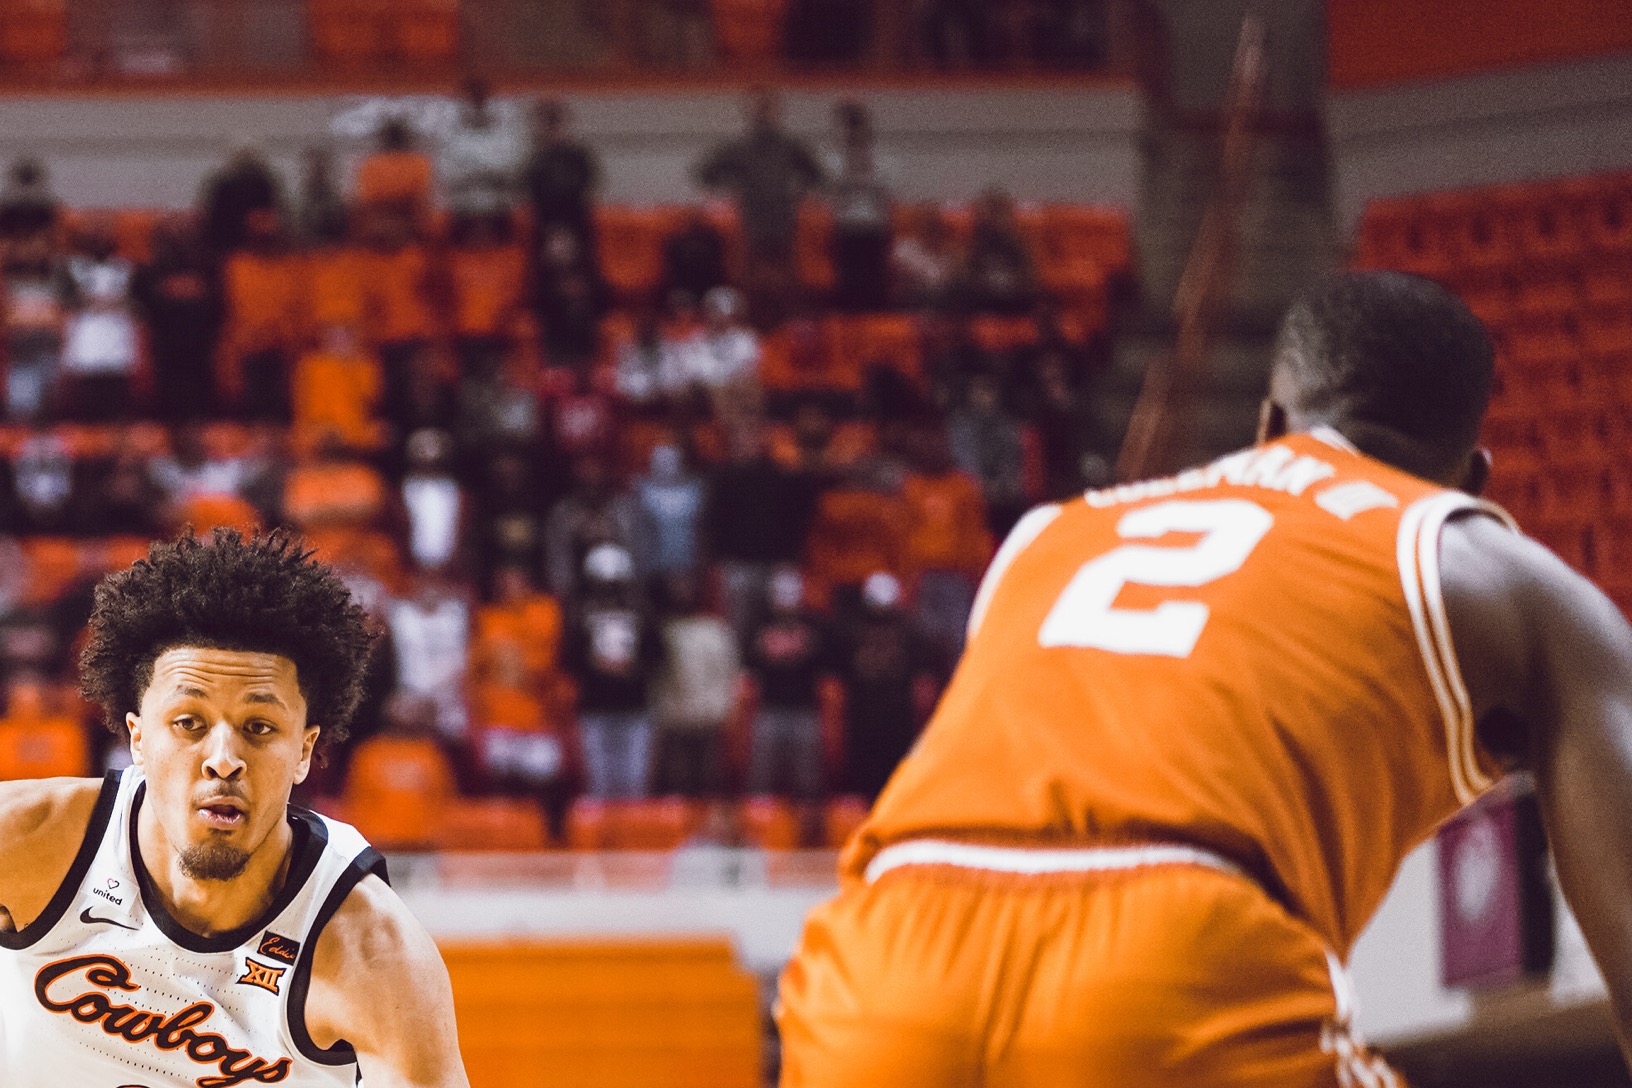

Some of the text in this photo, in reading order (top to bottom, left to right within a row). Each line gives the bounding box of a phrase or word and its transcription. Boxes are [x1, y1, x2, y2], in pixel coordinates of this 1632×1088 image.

[1037, 499, 1273, 658] 2
[93, 888, 123, 906] united
[259, 936, 295, 959] Eddie
[238, 958, 286, 994] XII
